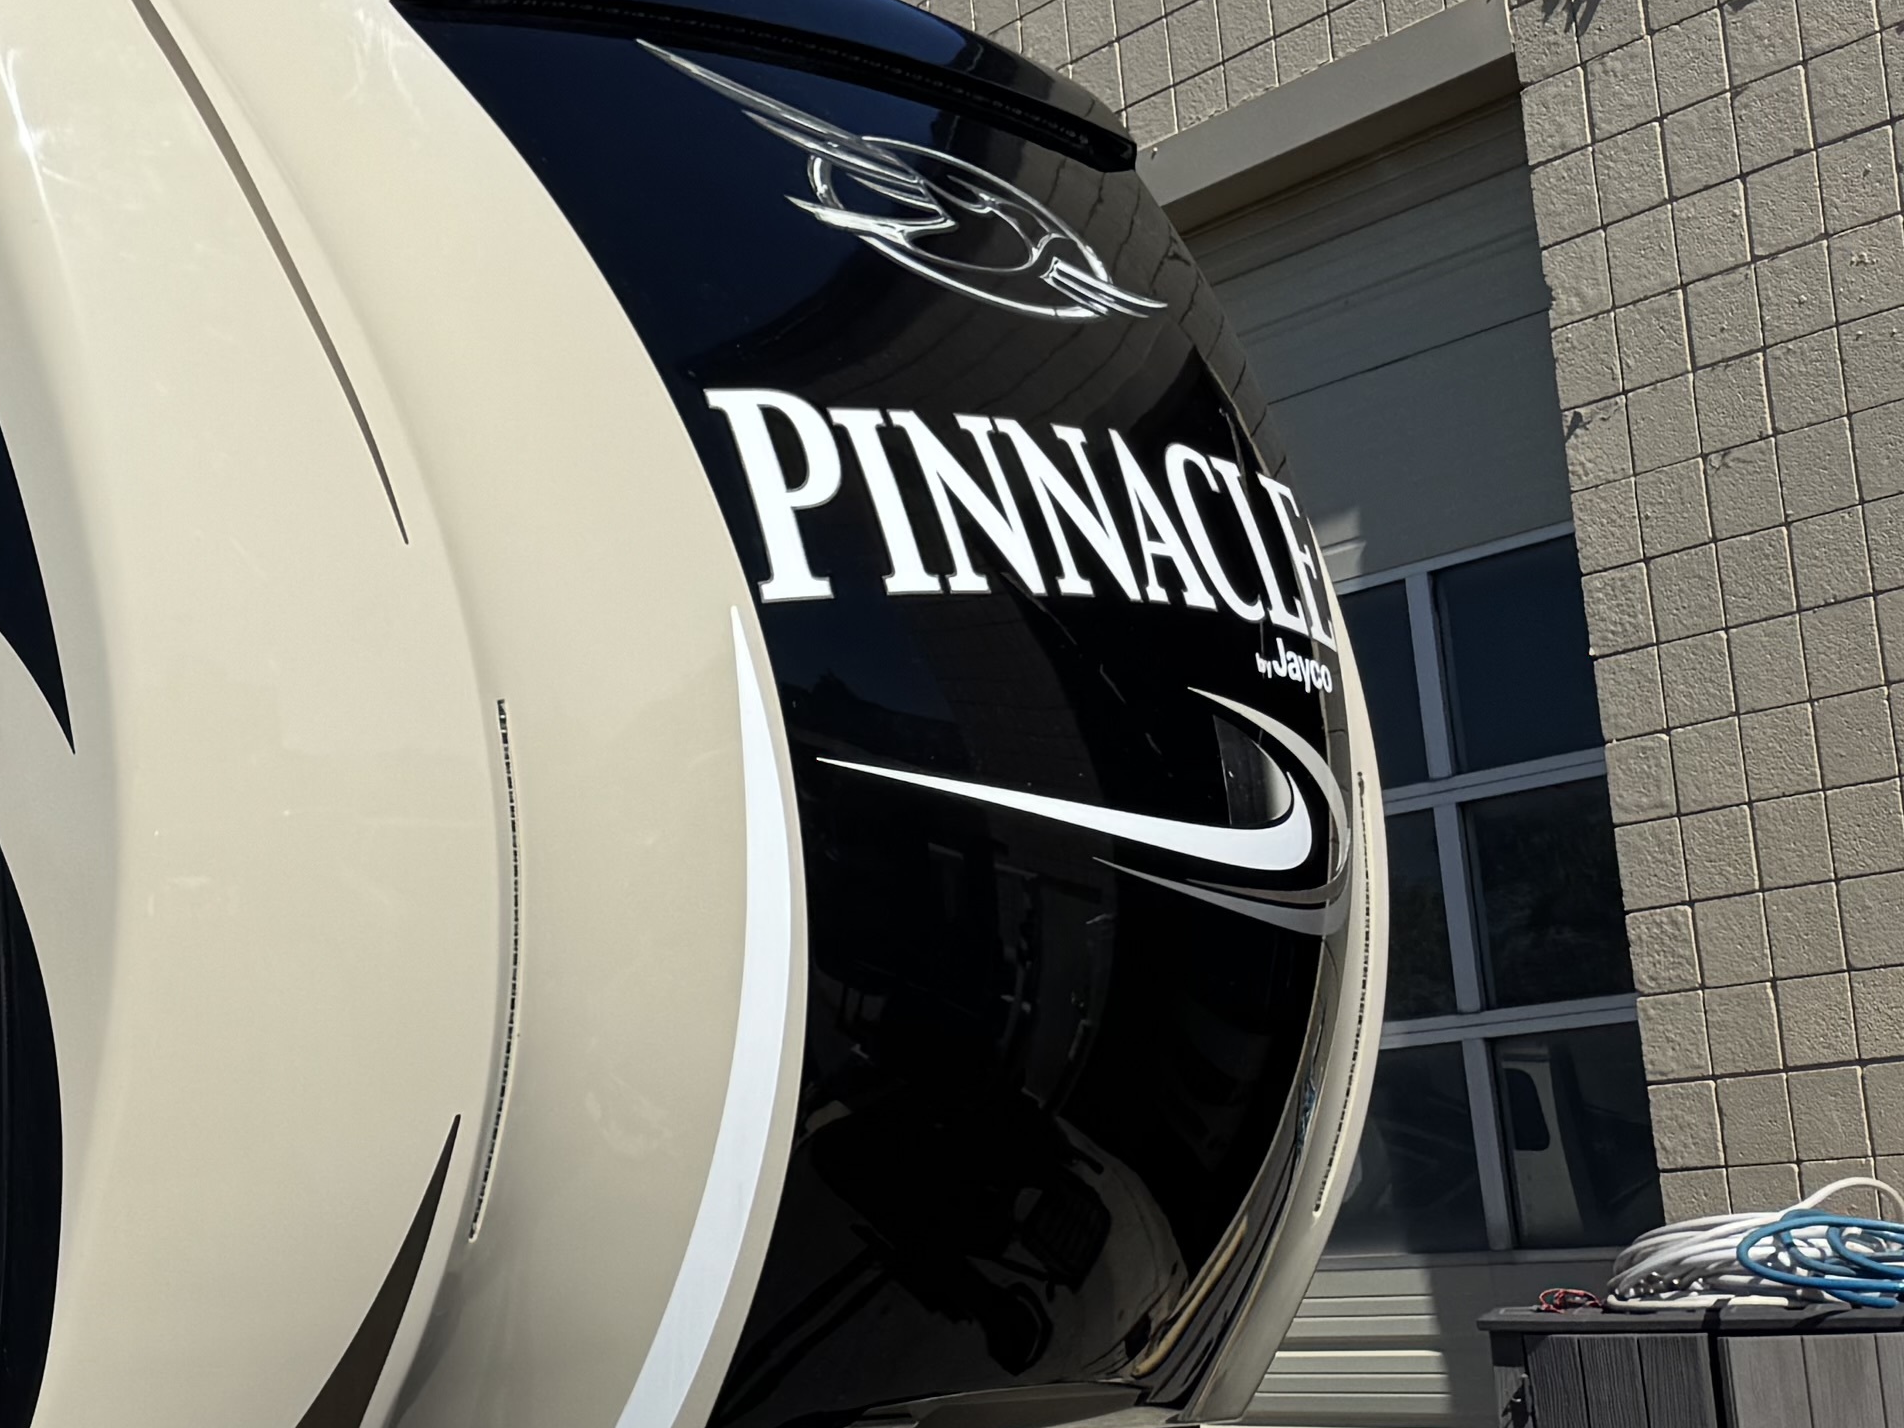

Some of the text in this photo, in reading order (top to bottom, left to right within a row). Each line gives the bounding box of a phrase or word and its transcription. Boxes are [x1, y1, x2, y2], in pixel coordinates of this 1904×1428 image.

[703, 387, 1338, 653] PINNACLE
[1255, 637, 1333, 694] by Jayco
